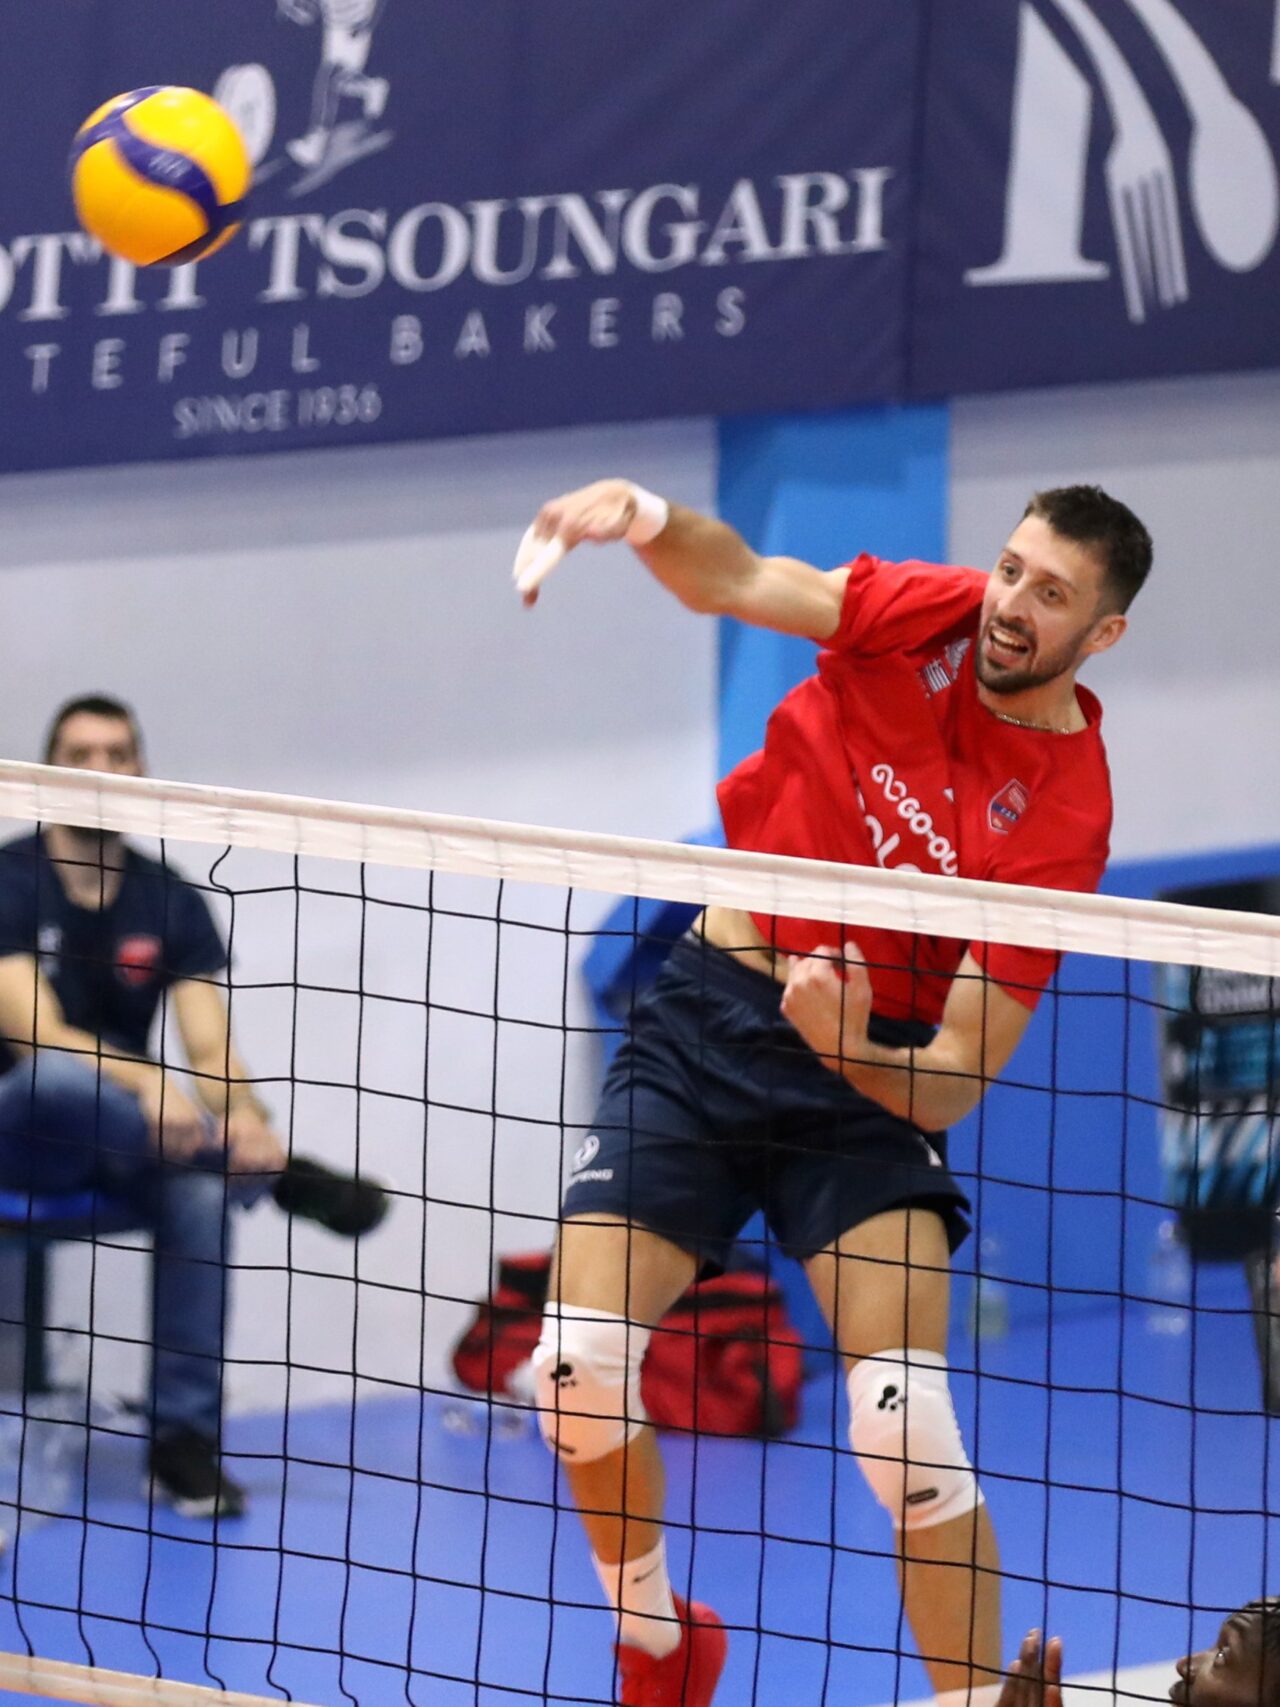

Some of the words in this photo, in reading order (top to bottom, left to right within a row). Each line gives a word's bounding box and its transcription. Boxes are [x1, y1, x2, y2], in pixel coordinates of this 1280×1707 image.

[248, 166, 894, 302] TSOUNGARI
[388, 286, 747, 365] BAKERS
[173, 391, 291, 438] SINCE
[297, 383, 383, 431] 1936
